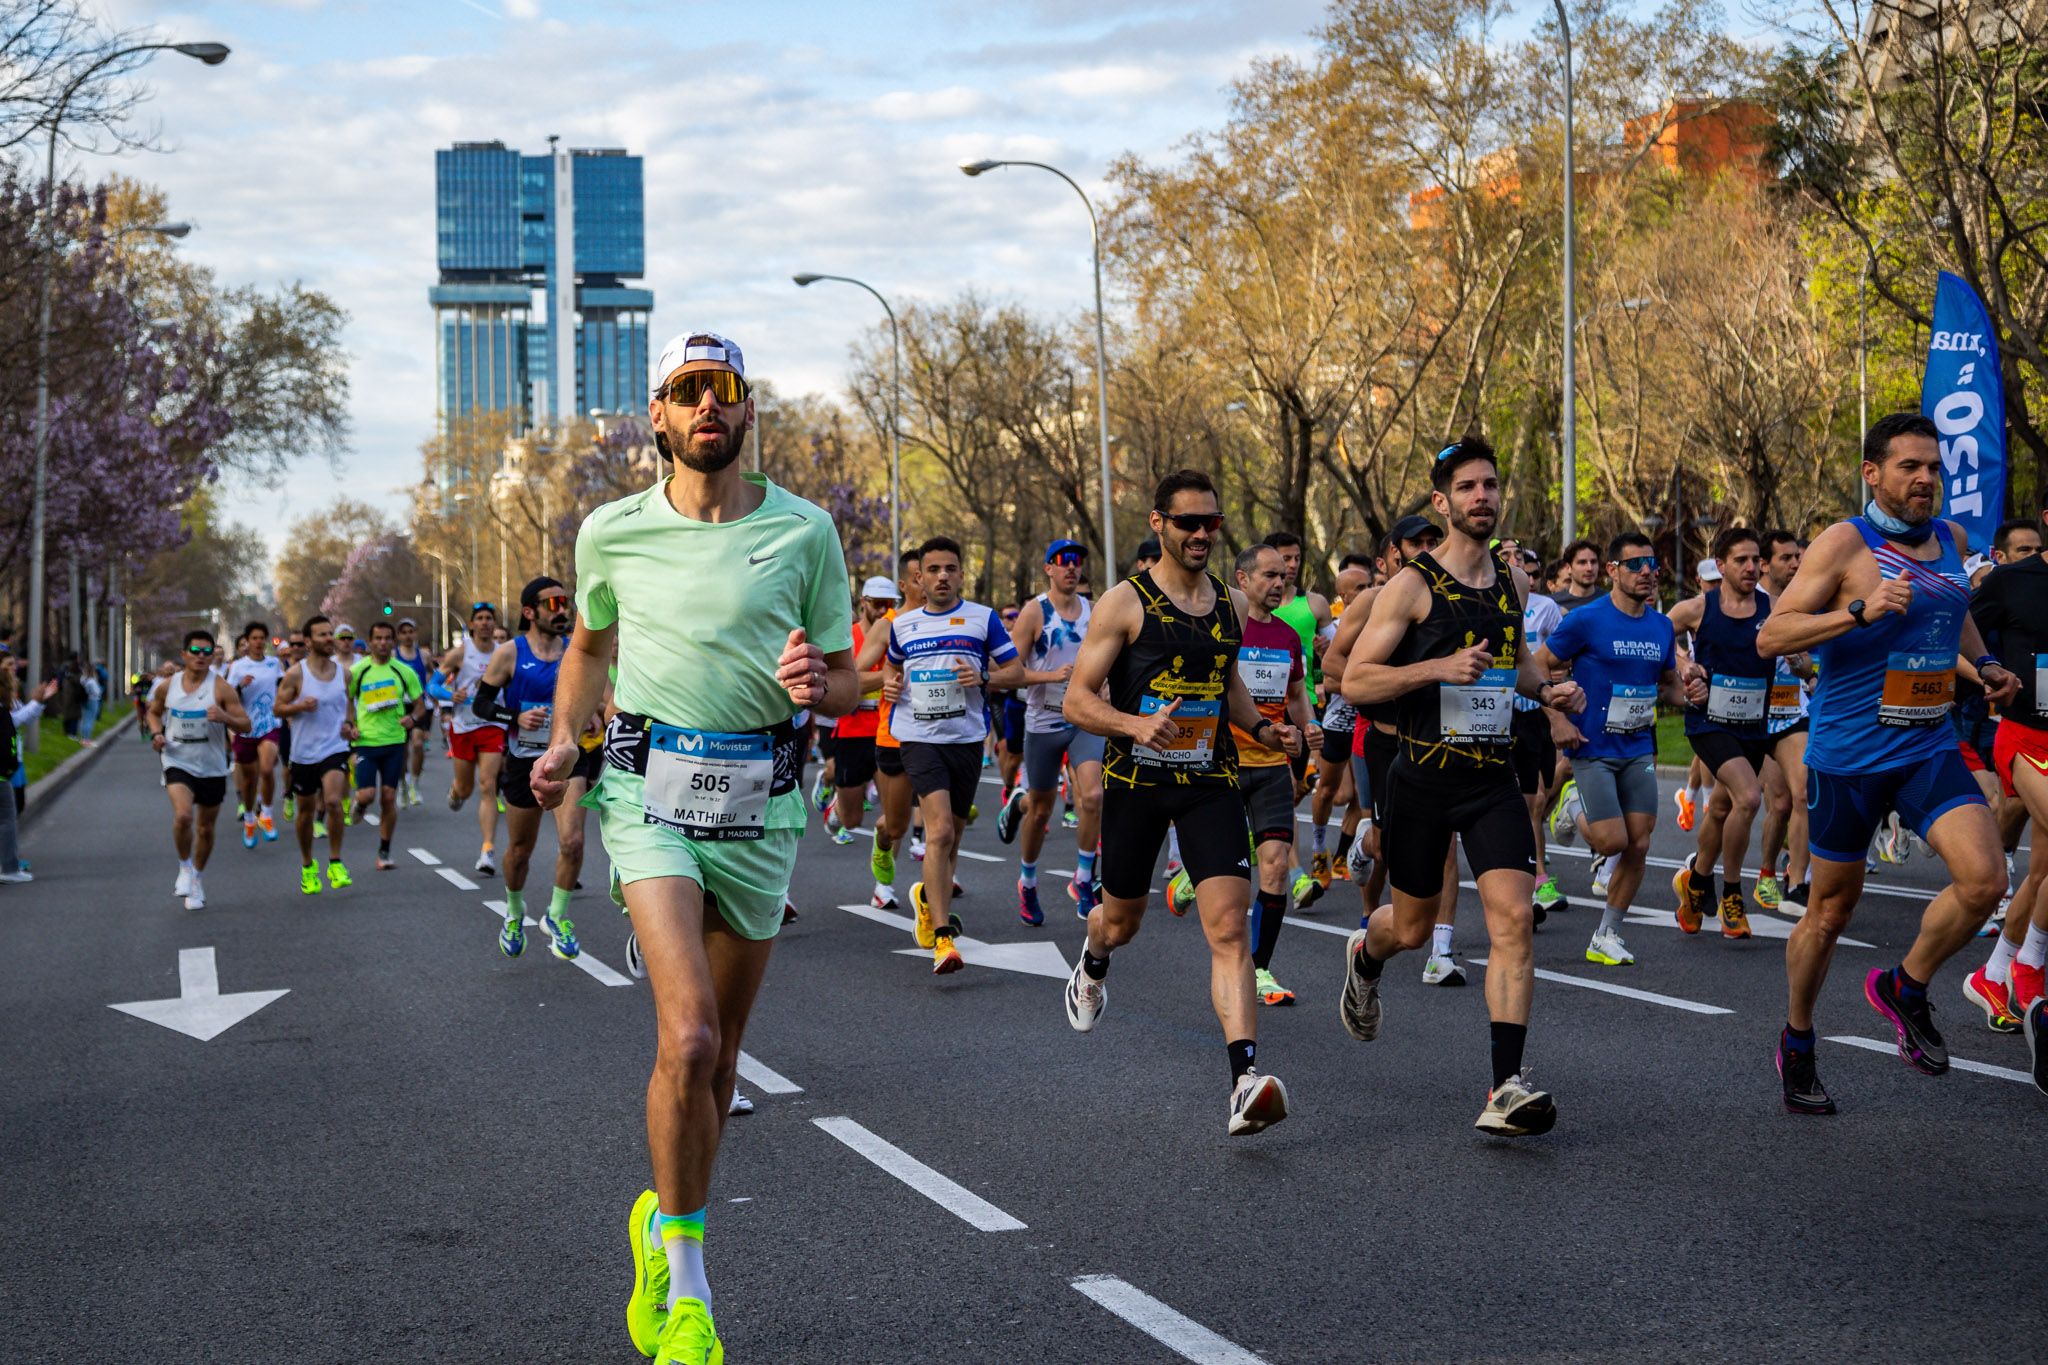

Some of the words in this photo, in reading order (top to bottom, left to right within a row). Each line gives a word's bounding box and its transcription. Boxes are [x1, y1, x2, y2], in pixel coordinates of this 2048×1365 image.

[1613, 640, 1660, 651] SUBARU
[1614, 648, 1661, 657] TRIATLON
[1255, 669, 1272, 679] 564
[928, 688, 946, 698] 353
[1911, 682, 1942, 694] 5463
[1471, 697, 1495, 710] 343
[1729, 695, 1748, 704] 434
[1469, 724, 1497, 732] JORGE
[709, 741, 752, 752] Movistar
[1159, 751, 1191, 759] NACHO
[690, 772, 730, 793] 505
[674, 808, 737, 824] MATHIEU
[727, 830, 759, 838] MADRID
